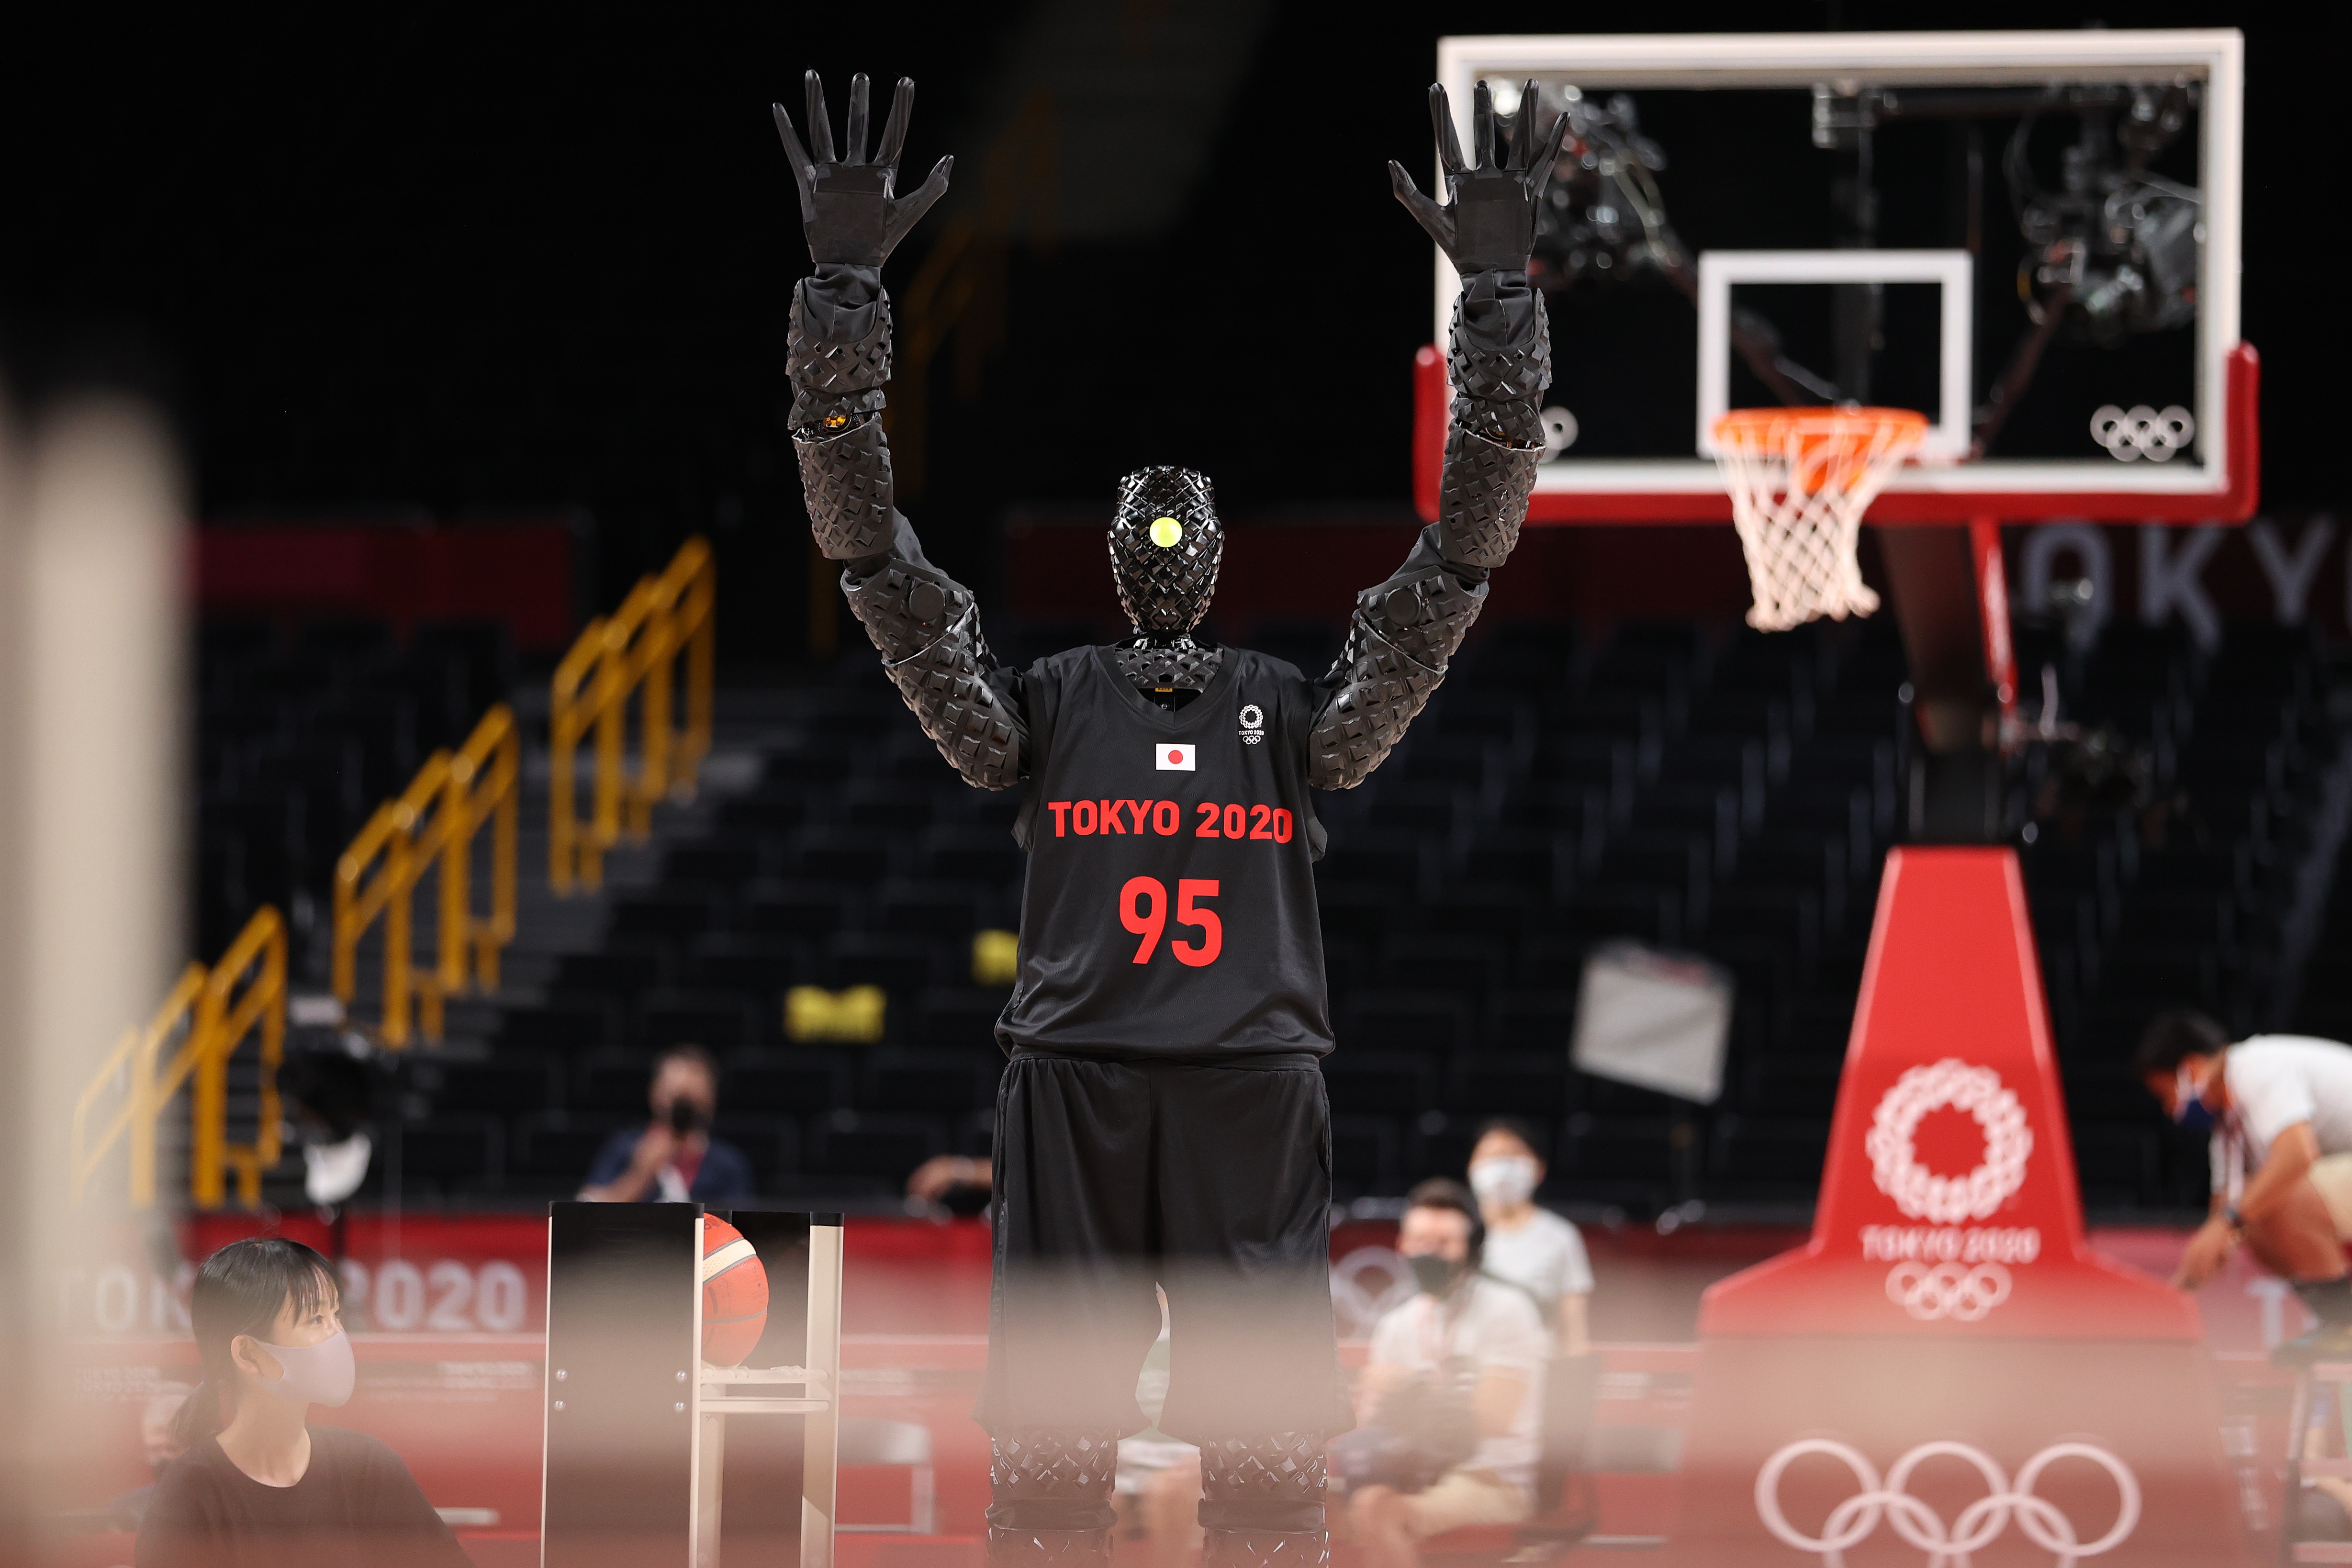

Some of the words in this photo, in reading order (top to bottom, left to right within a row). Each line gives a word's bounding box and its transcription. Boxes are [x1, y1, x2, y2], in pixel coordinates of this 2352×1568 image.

[2017, 515, 2352, 653] OKY
[1048, 799, 1180, 837] TOKYO
[1196, 802, 1293, 843] 2020
[1119, 875, 1222, 967] 95
